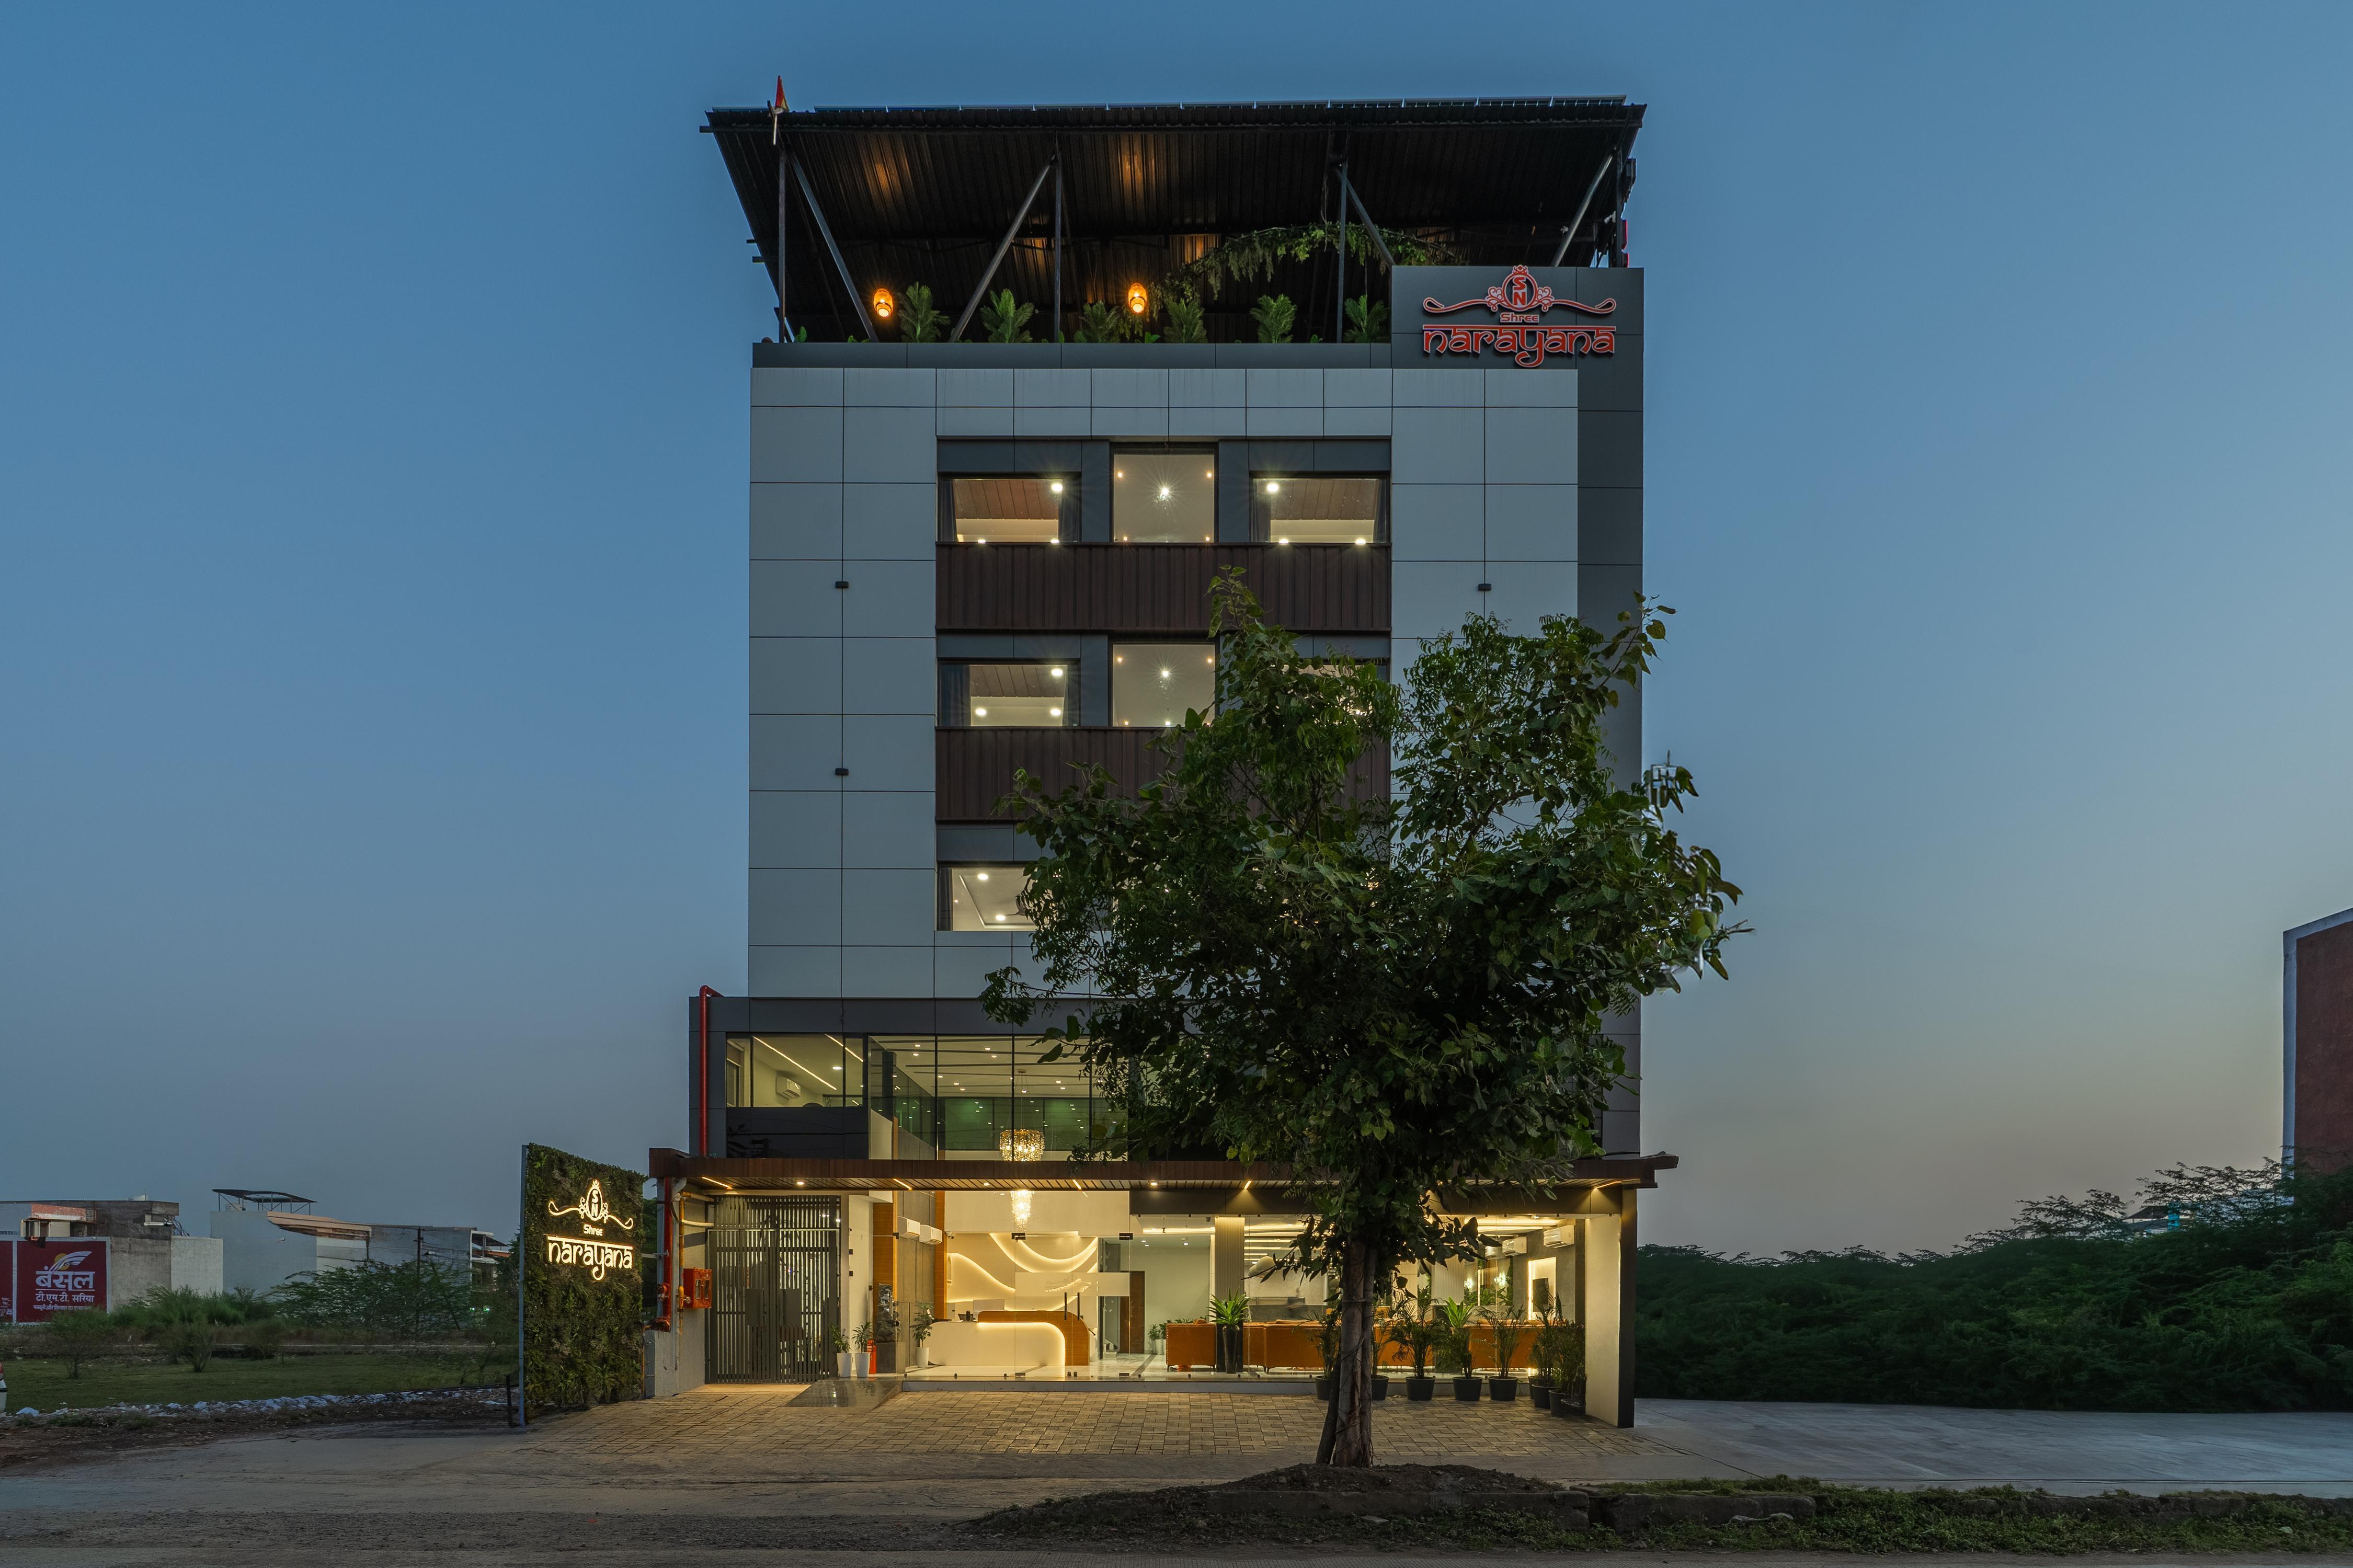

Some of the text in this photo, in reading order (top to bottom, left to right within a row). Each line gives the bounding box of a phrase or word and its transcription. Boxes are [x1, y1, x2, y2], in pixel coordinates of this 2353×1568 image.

[1500, 313, 1539, 323] Shree
[1423, 325, 1616, 368] narayana
[584, 1224, 603, 1237] Shree
[547, 1236, 633, 1280] narayana
[36, 1266, 95, 1291] बंसल
[72, 1292, 95, 1302] सरिया
